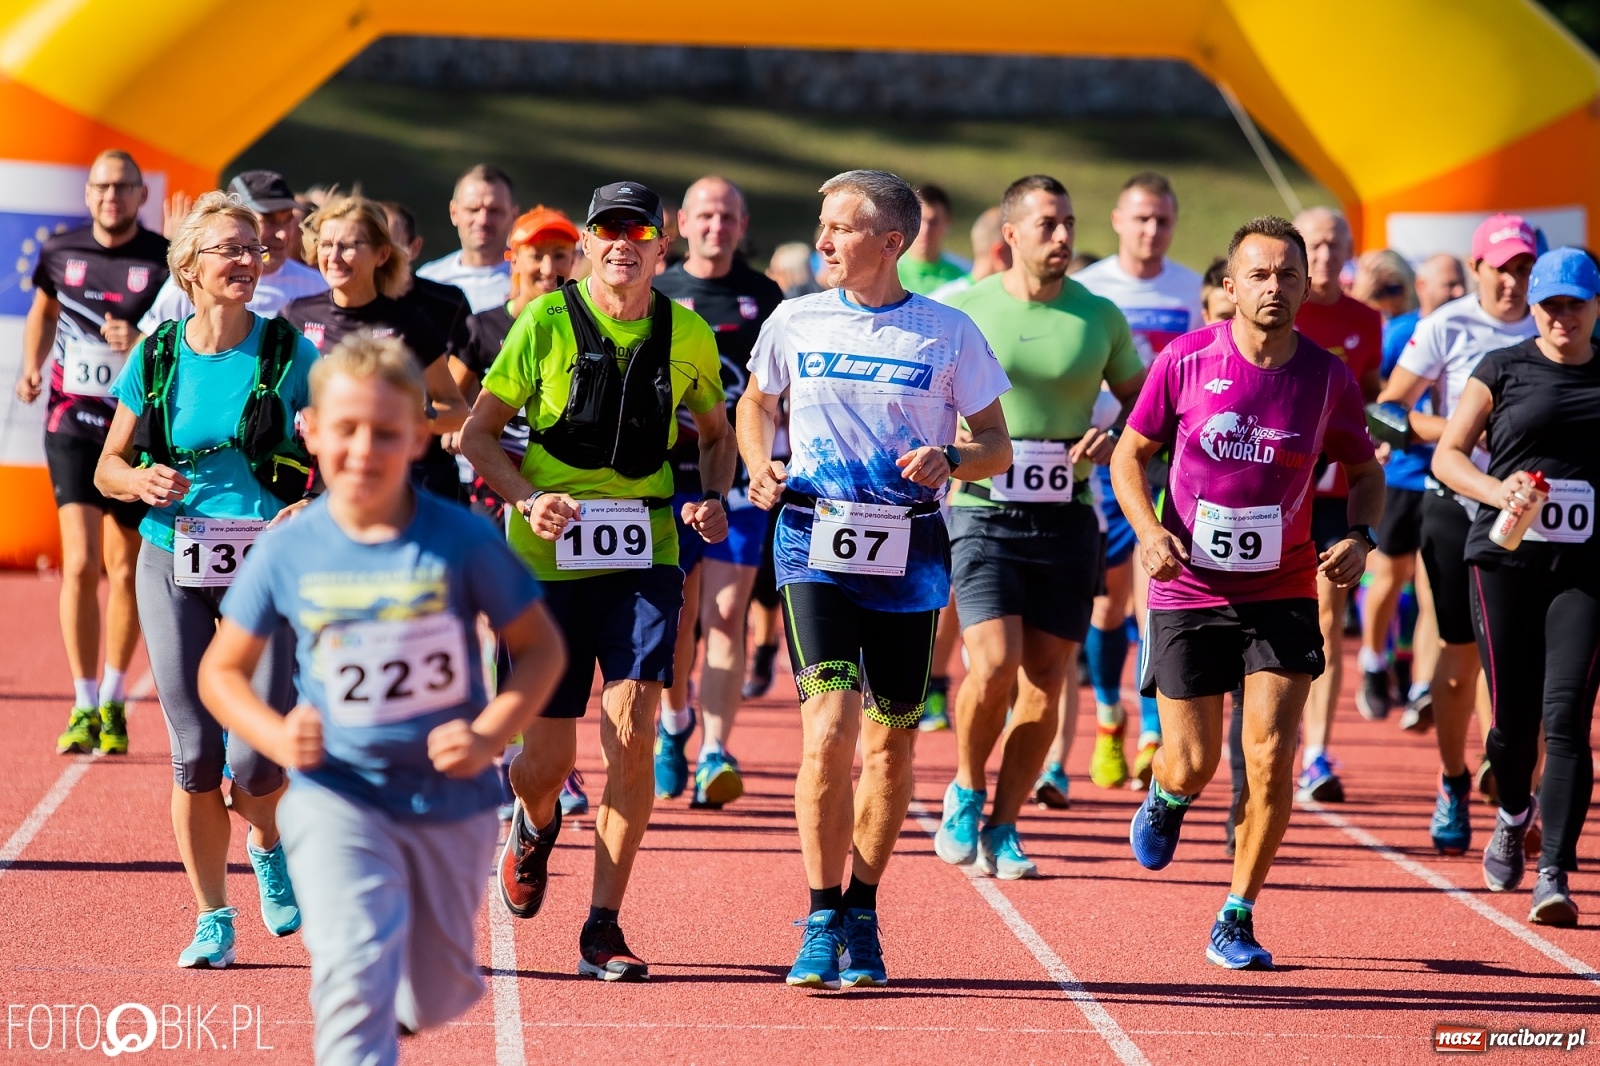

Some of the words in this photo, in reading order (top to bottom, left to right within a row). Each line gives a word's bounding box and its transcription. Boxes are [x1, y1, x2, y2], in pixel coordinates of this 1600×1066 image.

[832, 354, 925, 383] berger
[1204, 378, 1234, 394] 4F
[1218, 440, 1275, 464] WORLD
[1275, 449, 1305, 467] RUN
[1006, 463, 1068, 491] 166
[1223, 512, 1279, 521] www.personalbest.pl
[564, 524, 647, 556] 109
[832, 528, 889, 561] 67
[1210, 529, 1262, 560] 59
[339, 651, 455, 702] 223
